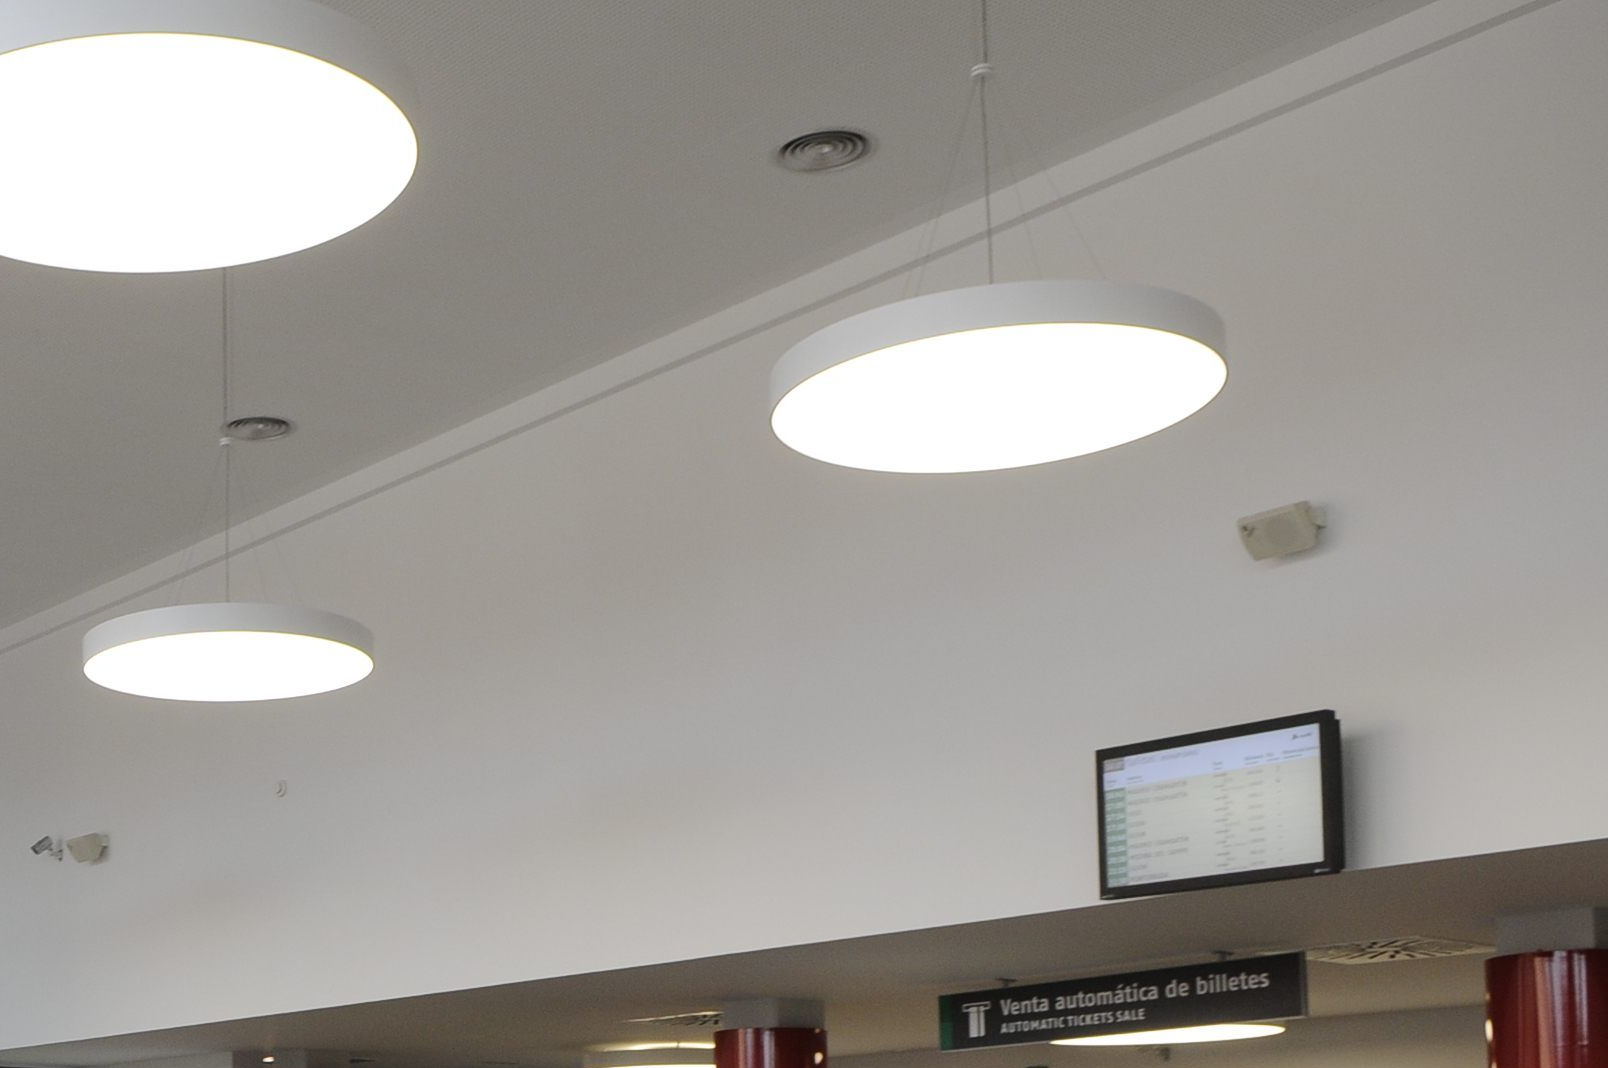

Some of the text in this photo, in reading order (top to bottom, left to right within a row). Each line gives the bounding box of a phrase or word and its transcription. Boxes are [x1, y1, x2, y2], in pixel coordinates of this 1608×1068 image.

[1000, 972, 1271, 1016] Venta automática de billetes
[1000, 1008, 1147, 1034] AUTOMATIC TICKETS SALE
